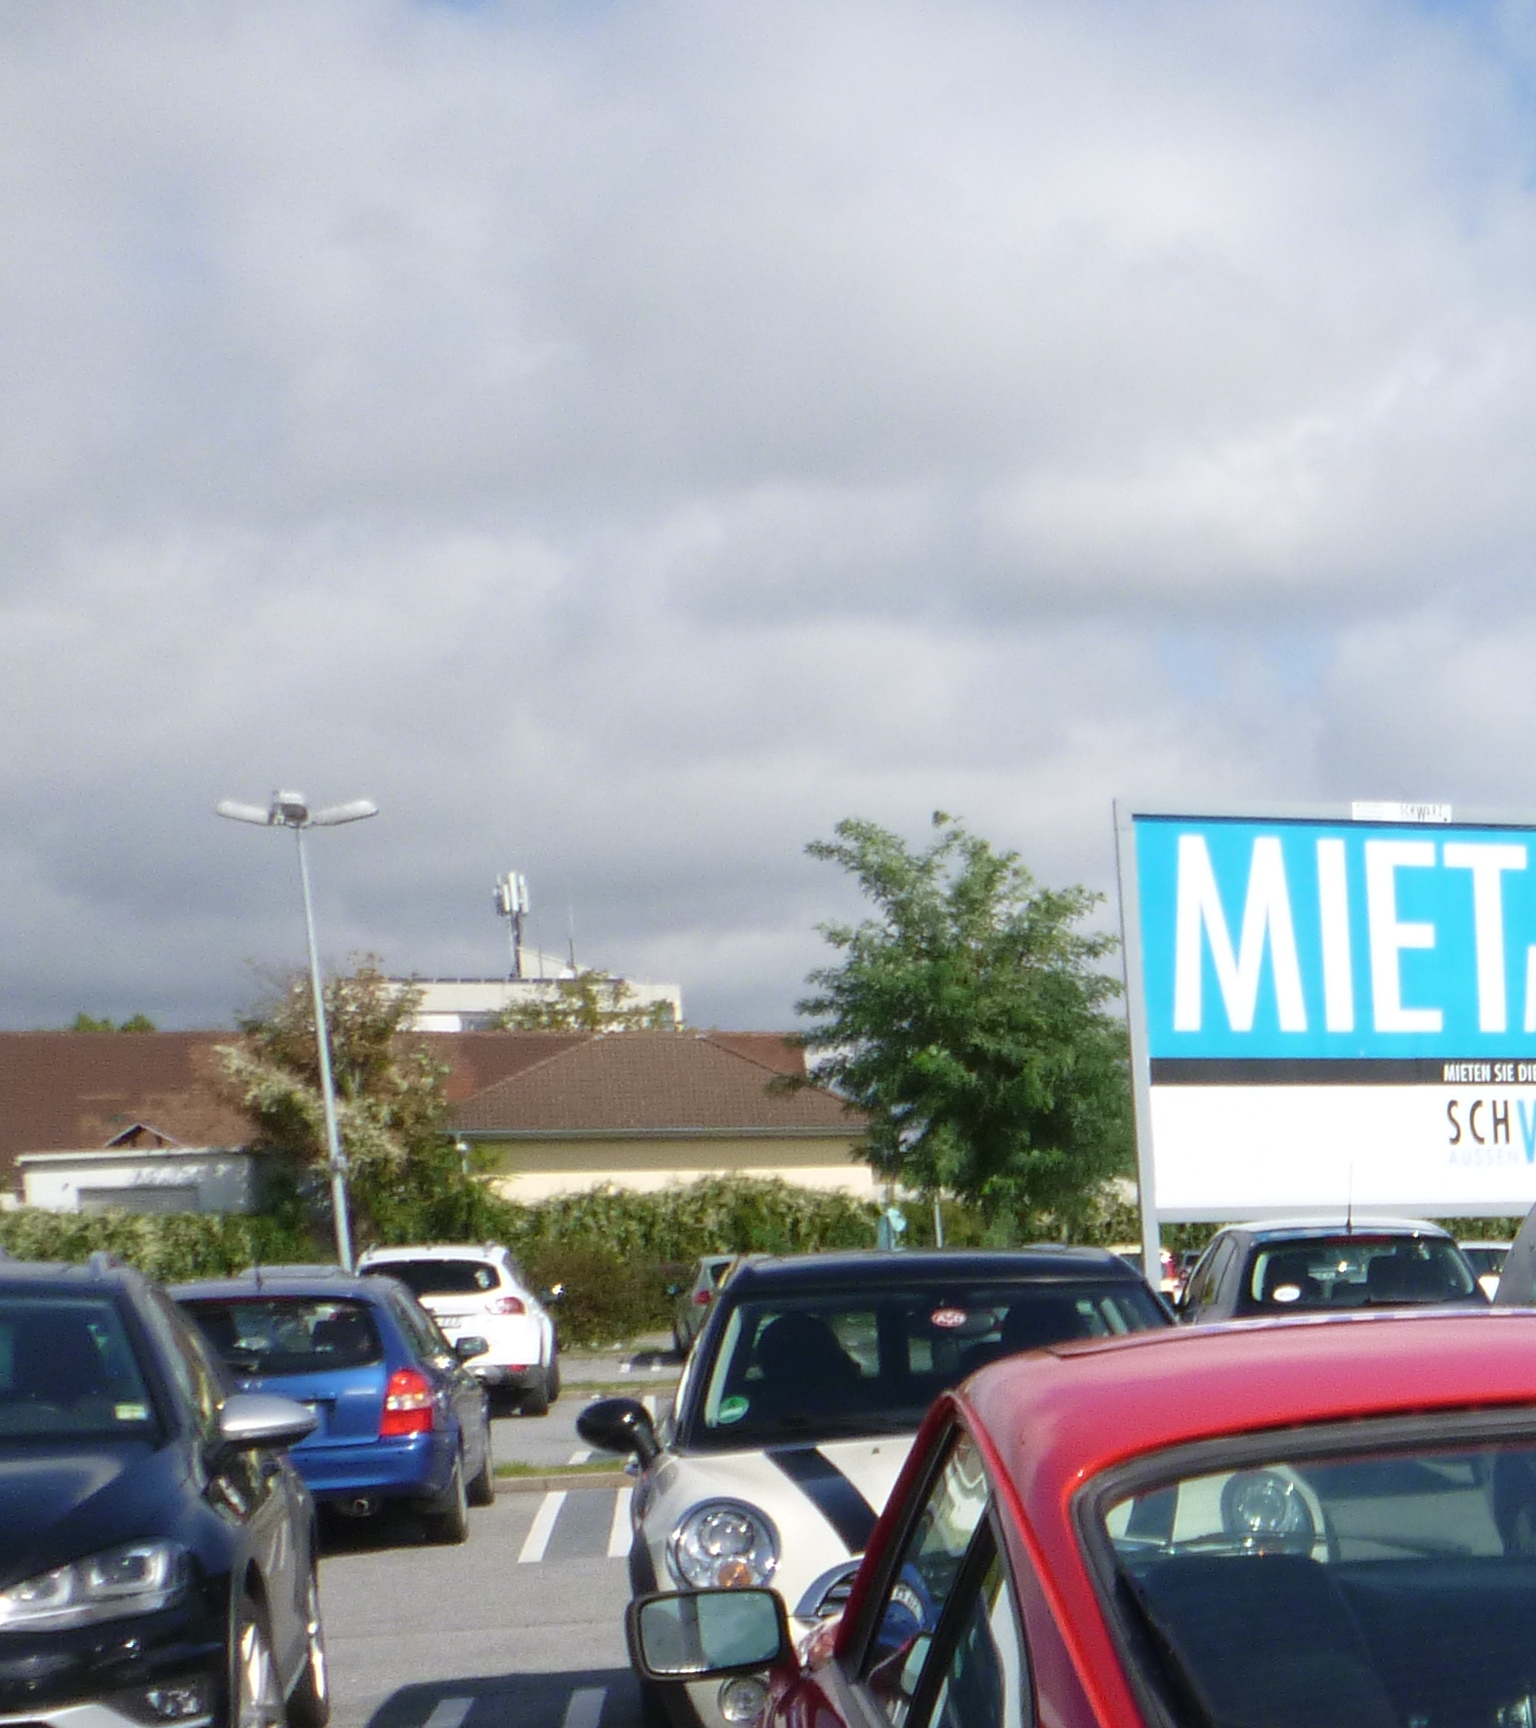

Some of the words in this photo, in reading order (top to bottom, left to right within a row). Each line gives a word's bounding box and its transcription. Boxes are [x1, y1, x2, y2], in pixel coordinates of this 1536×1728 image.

[1173, 833, 1527, 1033] MIET
[1443, 1062, 1491, 1082] MIETEN
[1494, 1063, 1515, 1082] SIE
